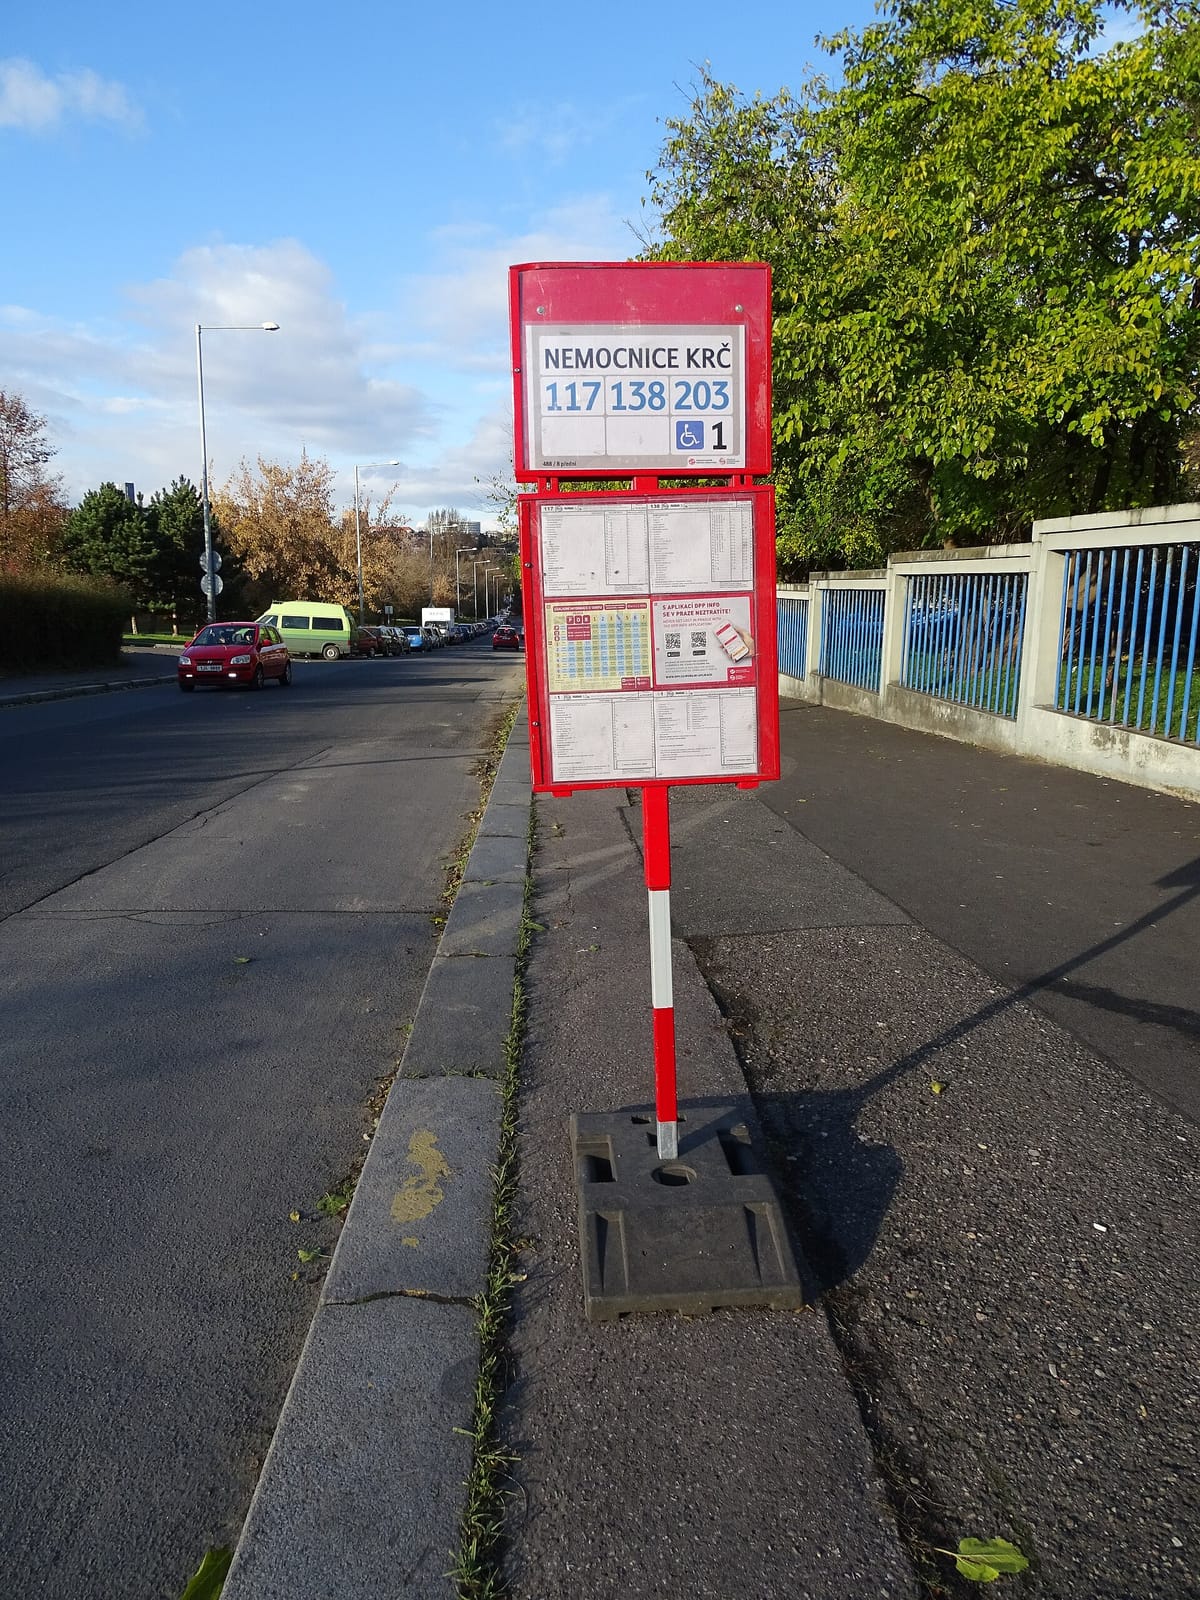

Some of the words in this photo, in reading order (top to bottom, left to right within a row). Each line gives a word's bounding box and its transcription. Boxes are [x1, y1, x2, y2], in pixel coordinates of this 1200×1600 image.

[544, 347, 679, 369] NEMOCNICE
[686, 342, 731, 369] KRČ
[545, 381, 601, 411] 117
[611, 381, 666, 411] 138
[674, 381, 730, 410] 203
[711, 421, 727, 450] 1
